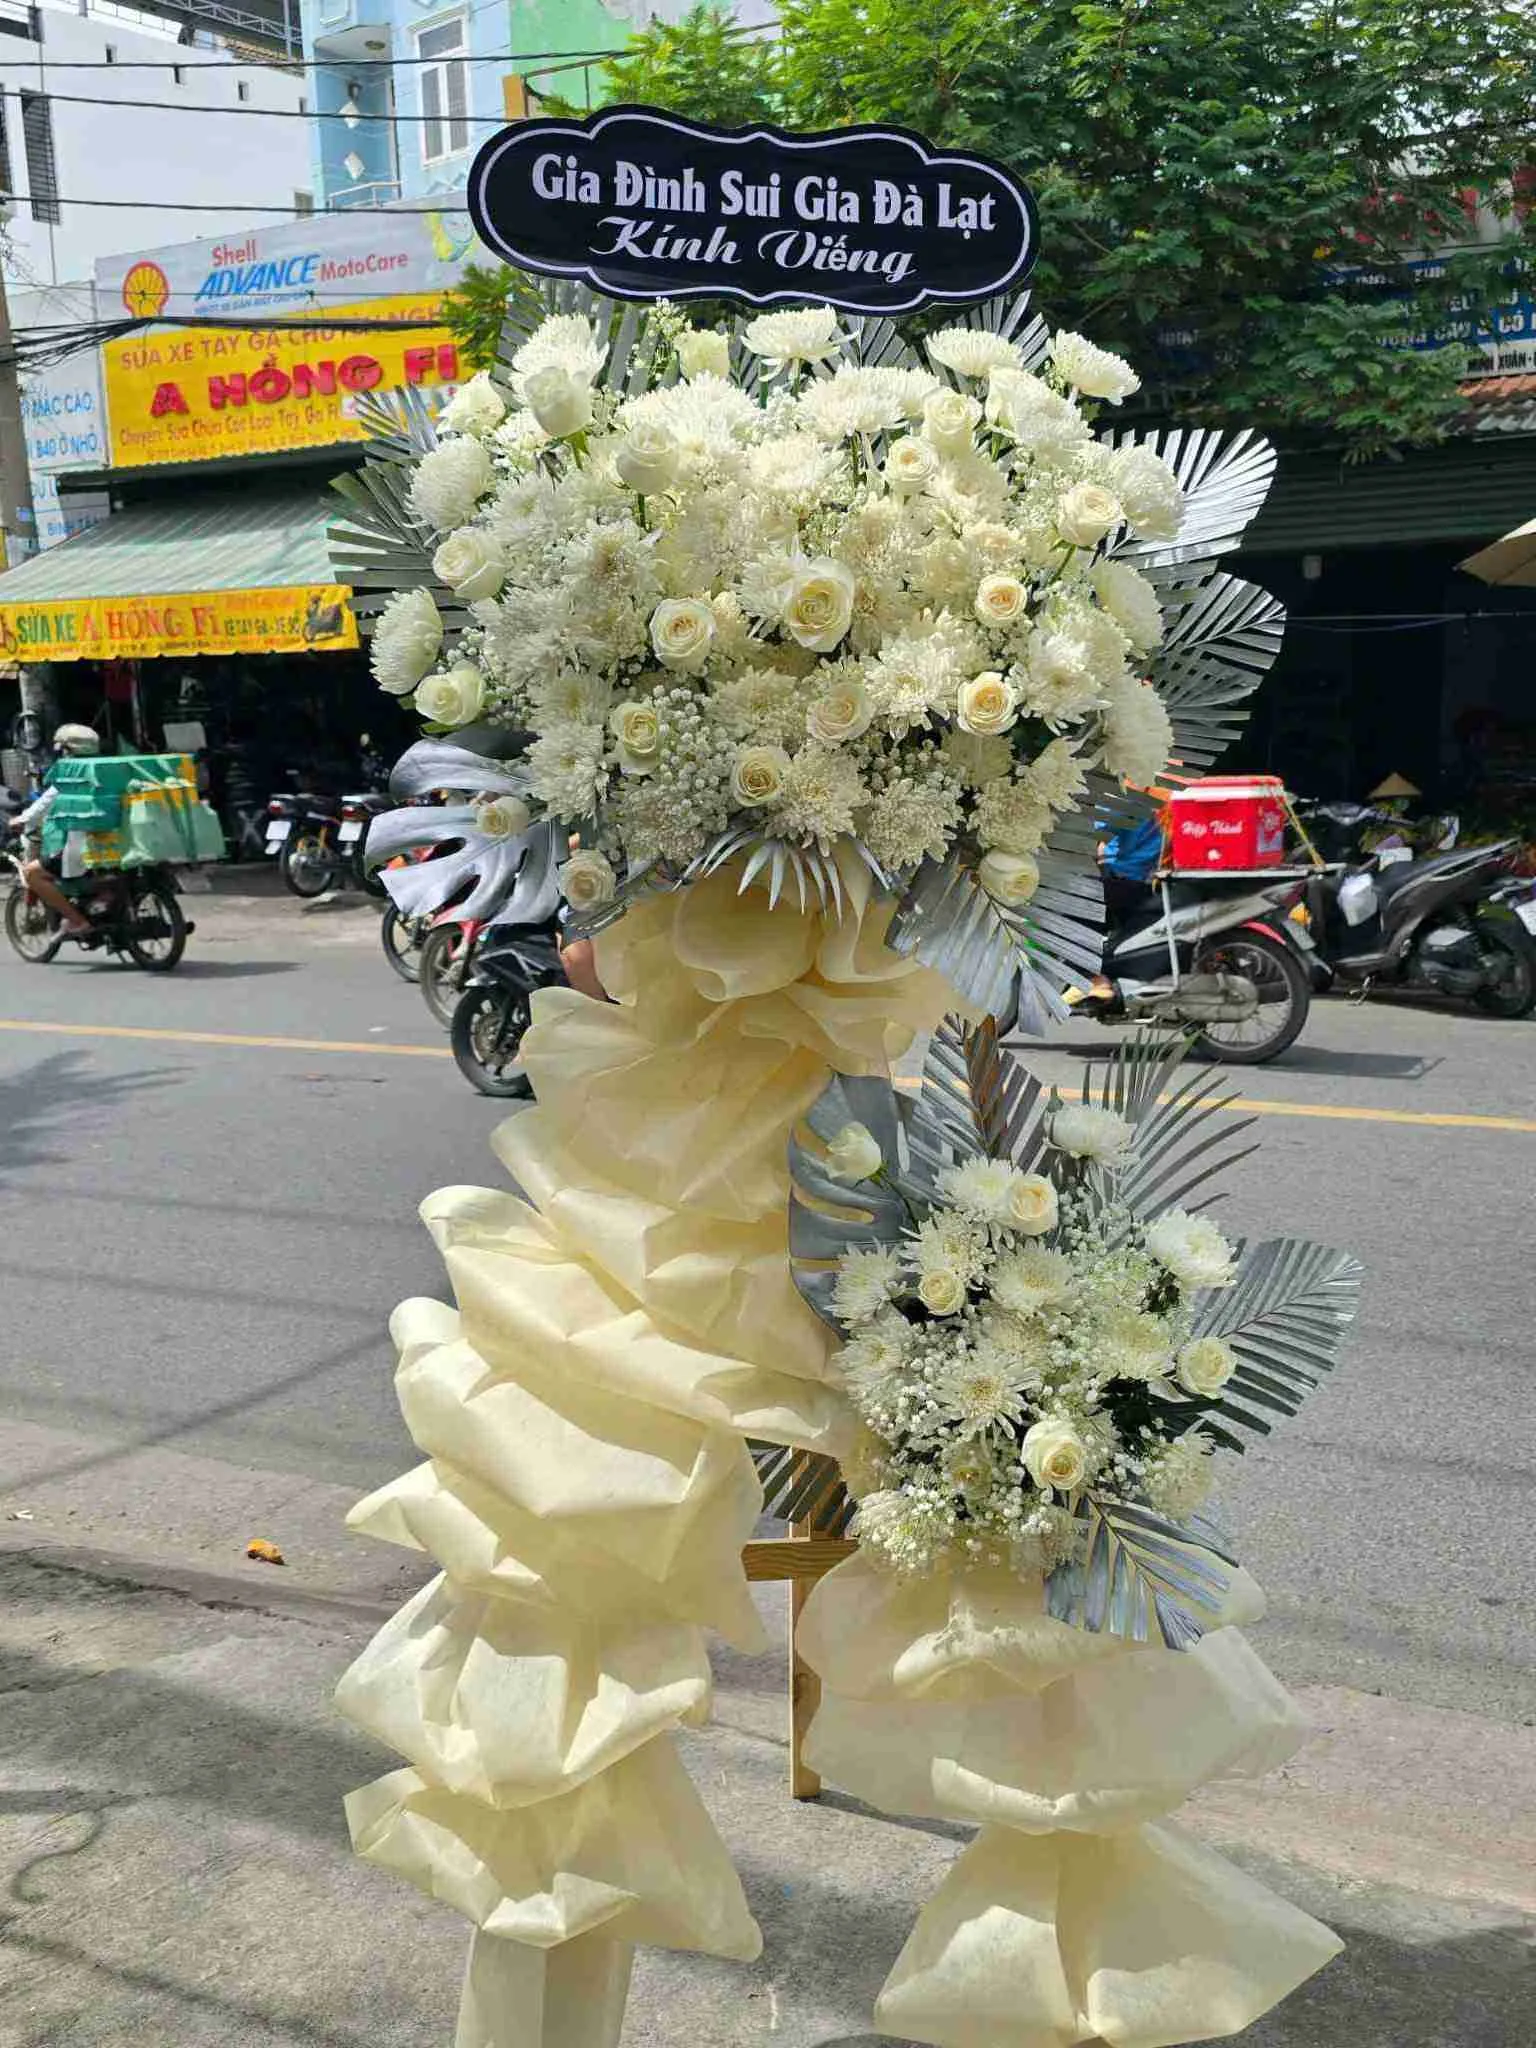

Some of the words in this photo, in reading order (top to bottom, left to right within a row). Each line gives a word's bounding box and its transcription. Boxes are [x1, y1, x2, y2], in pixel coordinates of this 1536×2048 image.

[532, 153, 600, 203] Gia
[614, 160, 706, 213] Đình
[720, 170, 780, 218] Sui
[794, 175, 860, 223] Gia
[873, 179, 923, 226] Đà
[937, 183, 996, 240] Lạt
[211, 239, 257, 267] Shell
[589, 215, 742, 264] Kính
[758, 229, 917, 283] Viếng
[194, 254, 321, 301] ADVANCE
[320, 252, 409, 282] MotoCare
[170, 341, 194, 363] XE
[201, 334, 241, 359] TAY
[150, 382, 190, 417] A
[81, 612, 100, 641] A
